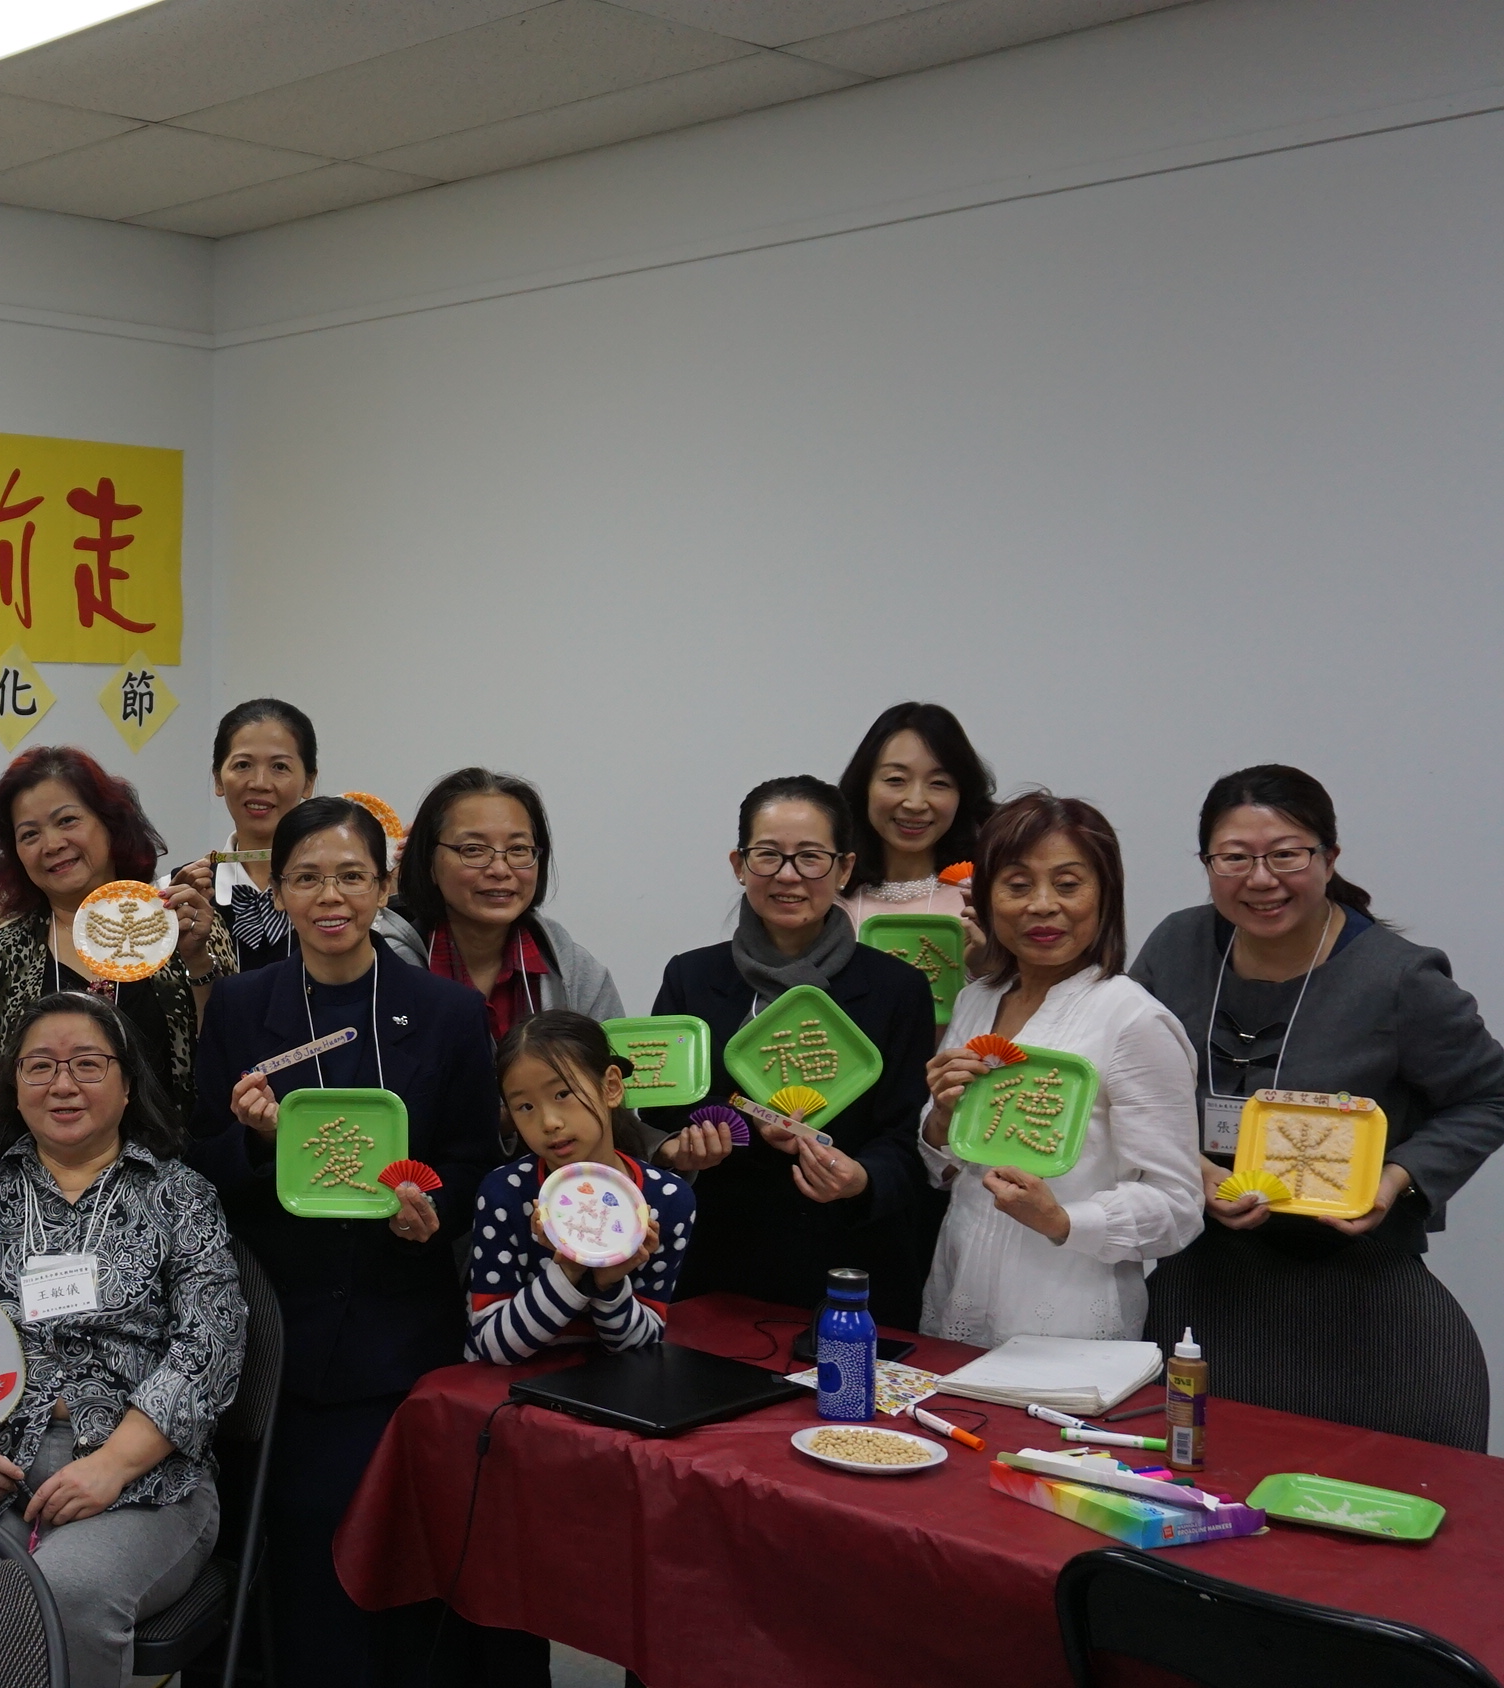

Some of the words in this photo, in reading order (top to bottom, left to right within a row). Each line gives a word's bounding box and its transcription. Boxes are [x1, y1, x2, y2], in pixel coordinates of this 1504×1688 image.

[623, 1039, 677, 1088] 豆
[761, 1018, 839, 1083] 福
[752, 1106, 780, 1124] Mei
